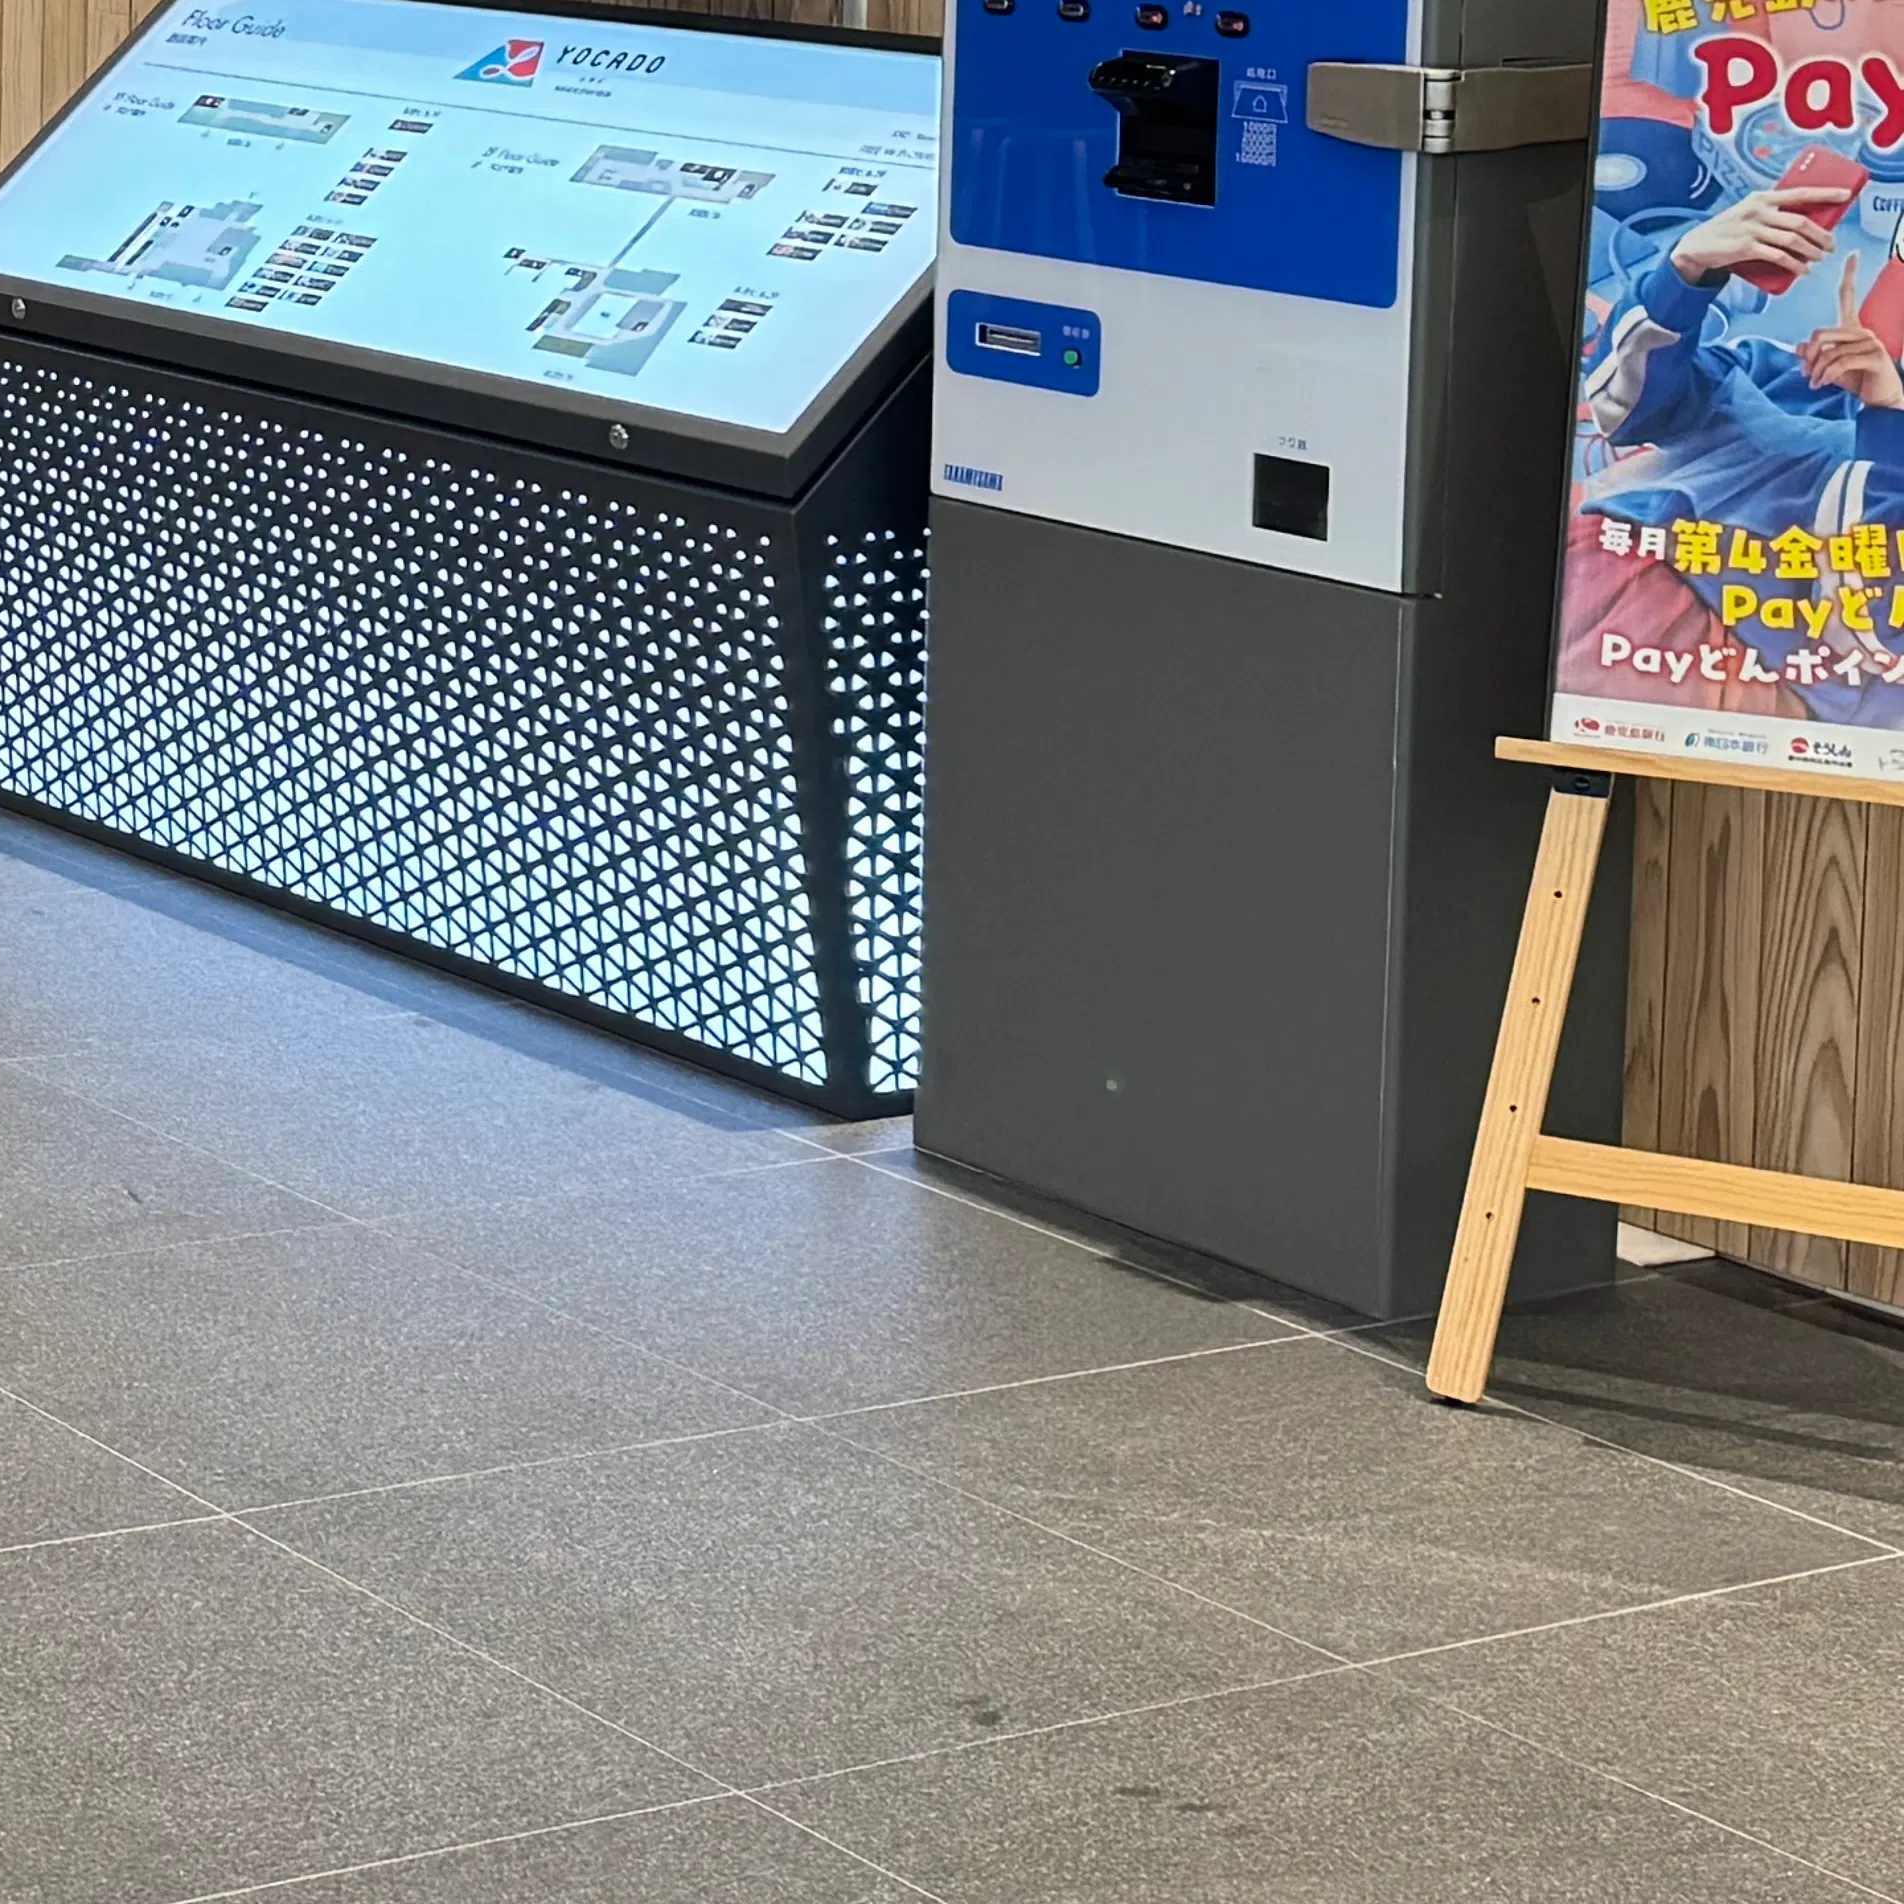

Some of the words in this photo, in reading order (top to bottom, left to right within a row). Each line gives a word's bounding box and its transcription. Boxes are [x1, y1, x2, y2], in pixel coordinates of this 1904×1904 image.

[231, 14, 287, 39] Guide
[556, 45, 666, 74] YOCADO
[1598, 517, 1904, 579] 毎月第4金曜
